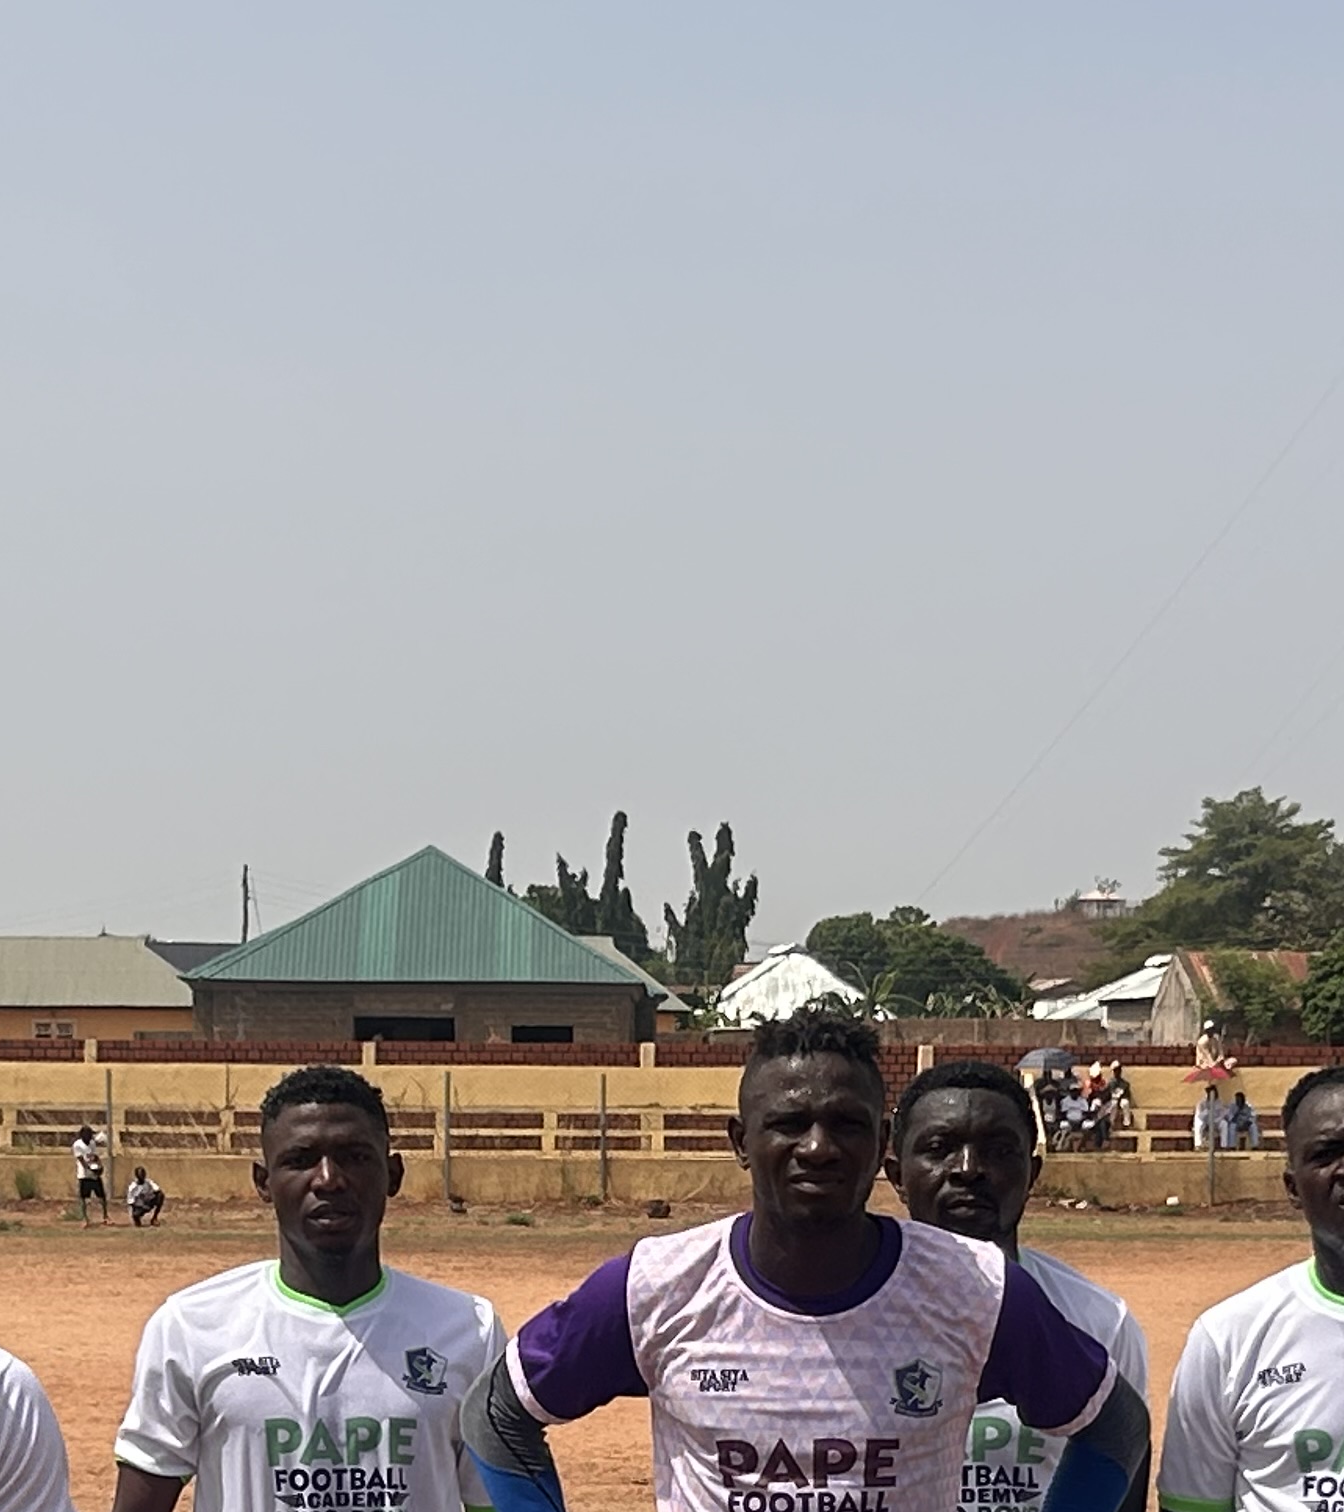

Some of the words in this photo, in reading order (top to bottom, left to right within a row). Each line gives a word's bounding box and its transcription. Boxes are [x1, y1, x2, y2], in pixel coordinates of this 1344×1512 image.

[265, 1417, 417, 1467] PAPE
[972, 1416, 1046, 1464] PE
[716, 1438, 899, 1488] PAPE
[274, 1467, 408, 1492] FOOTBALL
[961, 1465, 1039, 1488] TBALL
[295, 1492, 399, 1509] ACADEMY
[961, 1488, 1025, 1503] DEMY
